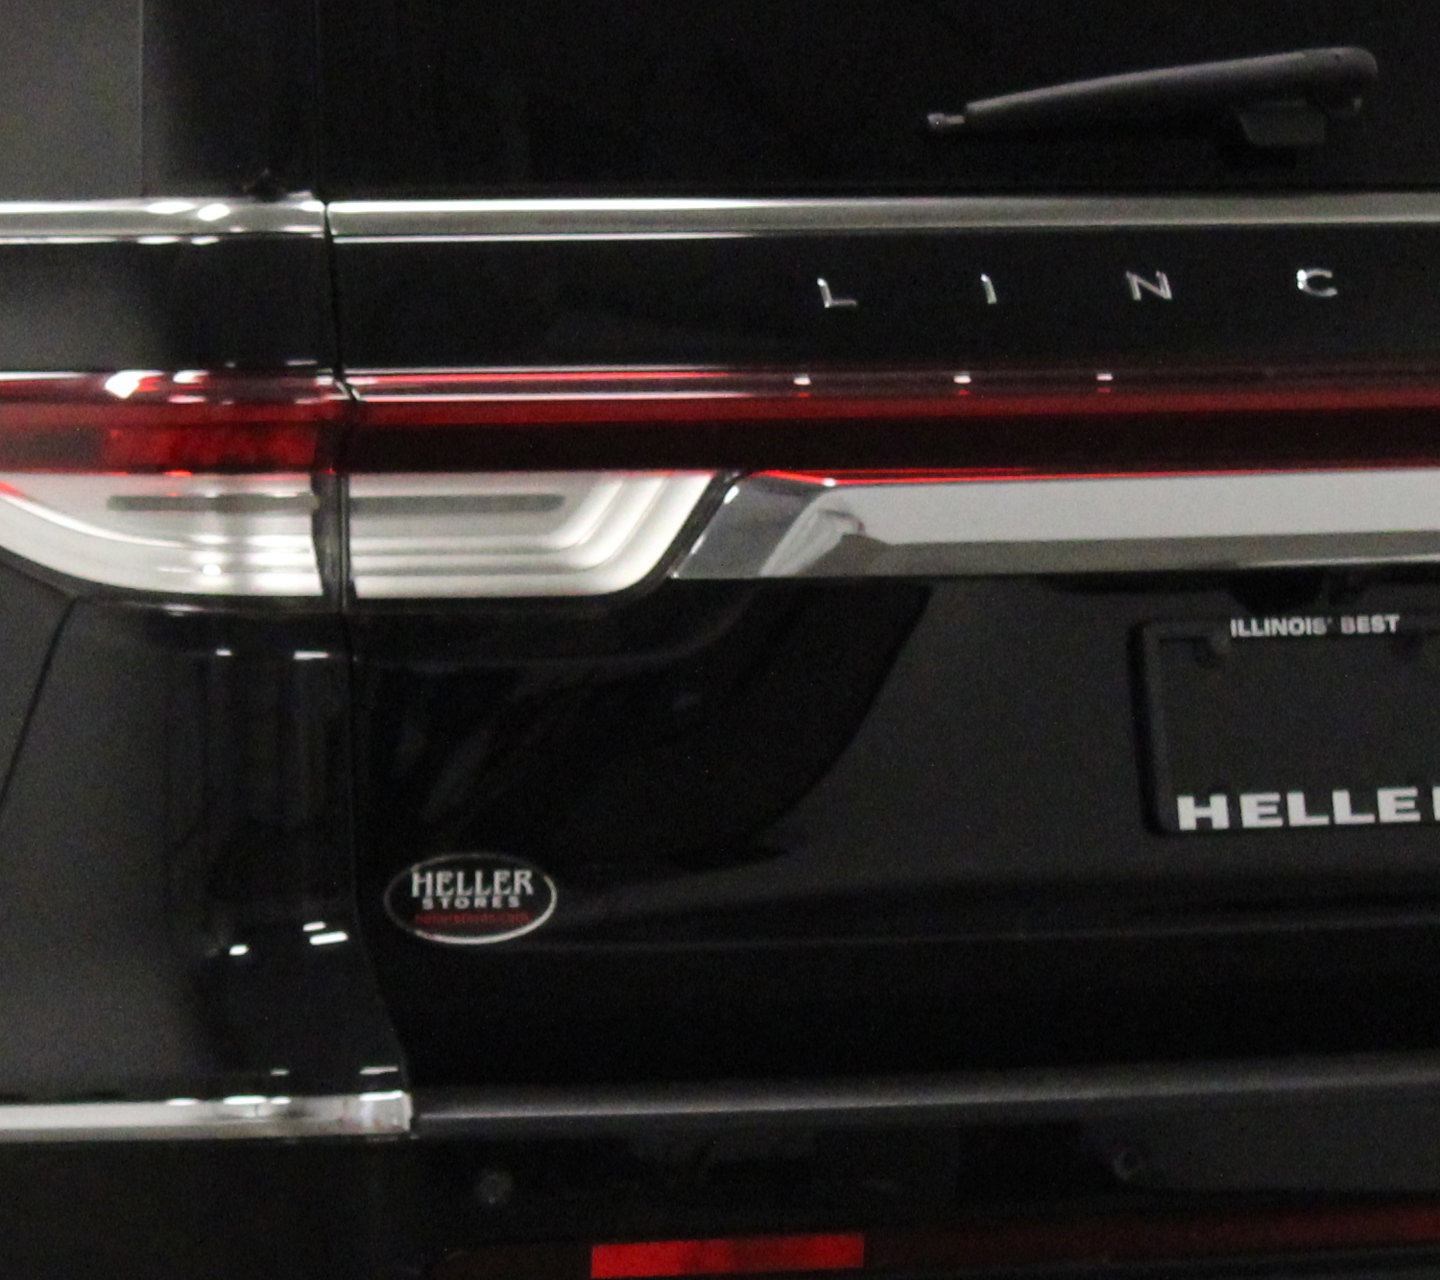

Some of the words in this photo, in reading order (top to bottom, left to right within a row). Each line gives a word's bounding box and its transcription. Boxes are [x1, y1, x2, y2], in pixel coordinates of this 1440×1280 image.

[1341, 614, 1400, 634] BEST
[411, 870, 534, 897] HELLER
[422, 896, 520, 909] STORES
